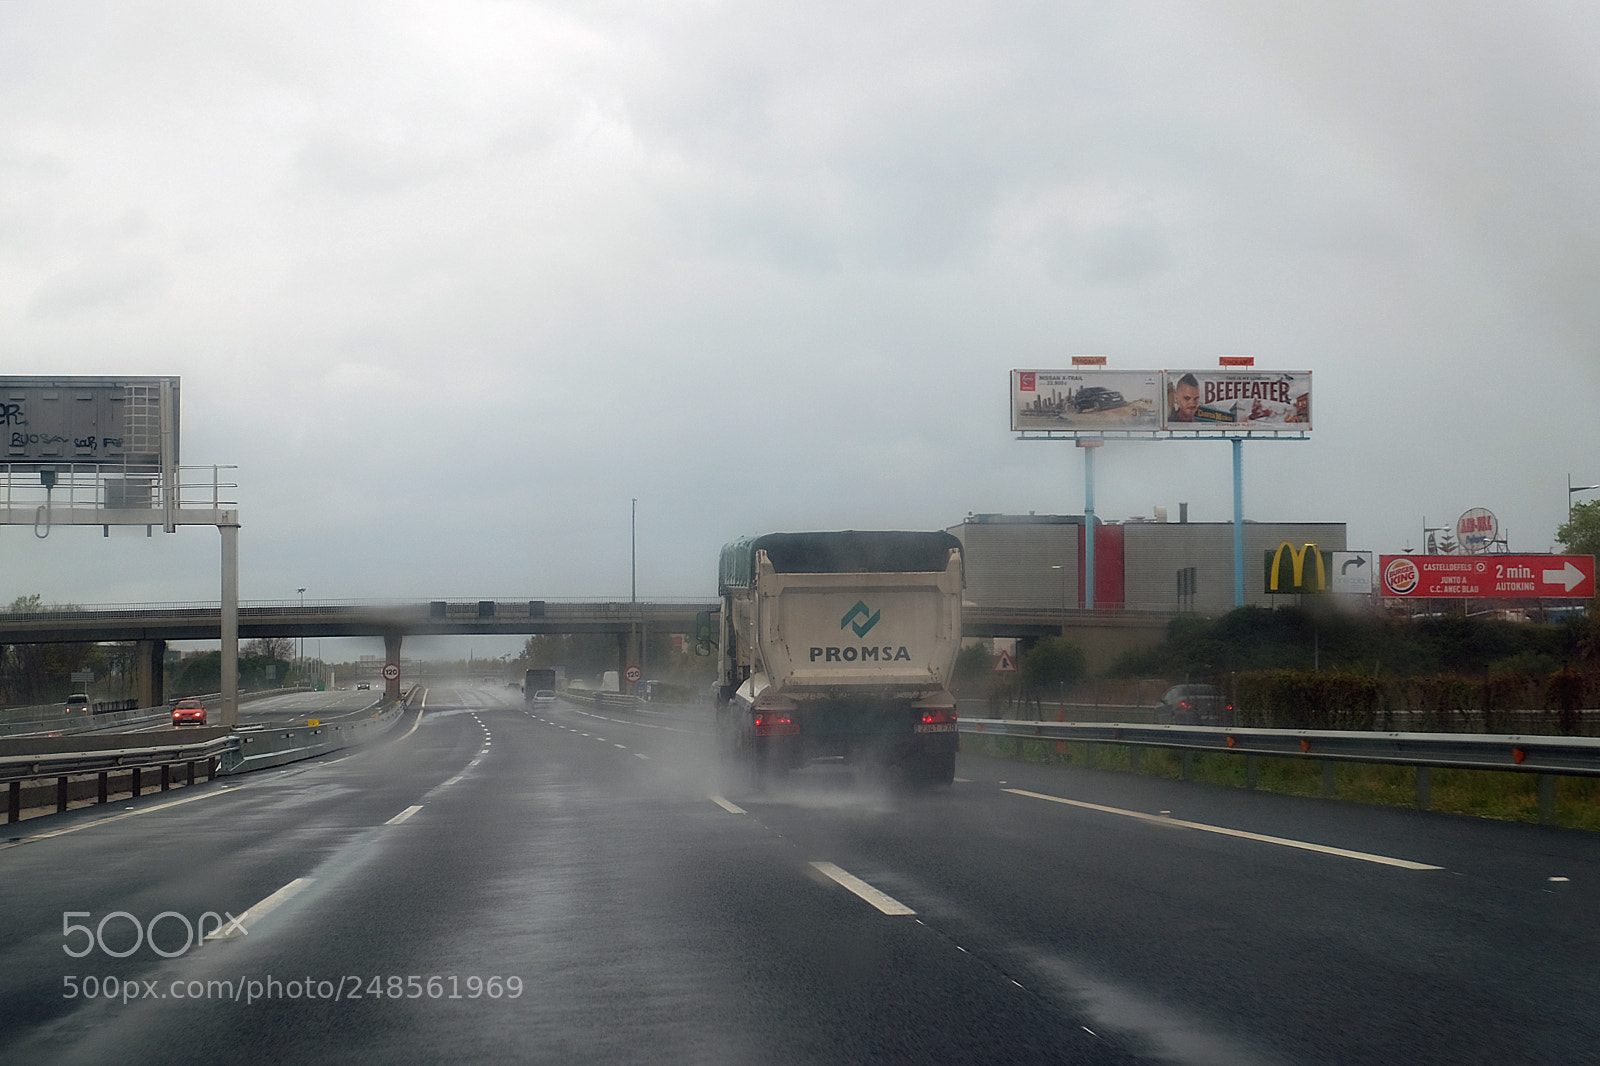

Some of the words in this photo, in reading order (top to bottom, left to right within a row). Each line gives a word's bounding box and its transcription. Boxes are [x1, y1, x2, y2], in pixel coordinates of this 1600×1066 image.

[1204, 381, 1290, 404] BEEFEATER
[1389, 565, 1414, 578] BURGER
[1423, 563, 1472, 571] CASTELLDEFELS
[1496, 564, 1504, 578] 2
[1506, 564, 1535, 578] min.
[1390, 571, 1415, 586] KING
[1440, 576, 1461, 584] JUNTO
[1462, 576, 1467, 584] A
[1429, 585, 1443, 593] C.C.
[1444, 585, 1461, 593] ANEC
[1462, 585, 1479, 593] BLAU
[1496, 582, 1535, 591] AUTOKING
[809, 646, 911, 662] PROMSA
[385, 668, 398, 677] 120
[627, 670, 640, 678] 120
